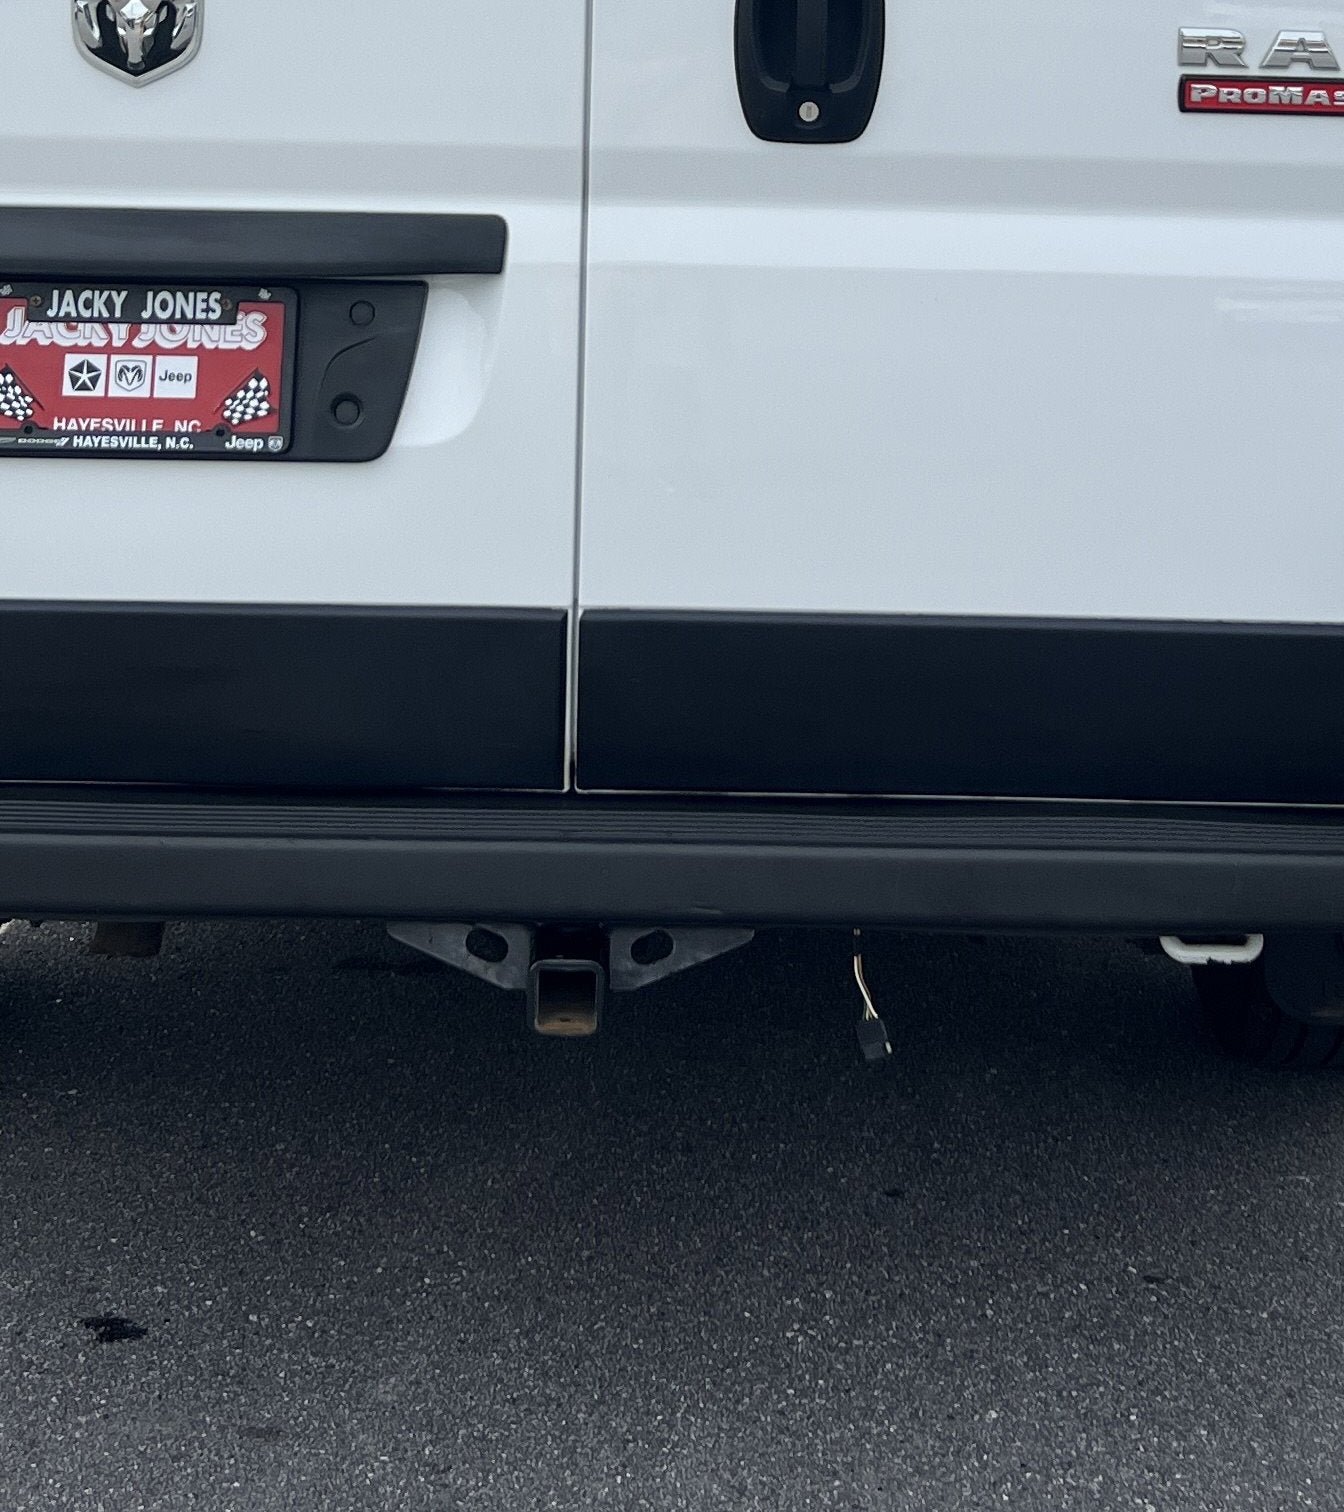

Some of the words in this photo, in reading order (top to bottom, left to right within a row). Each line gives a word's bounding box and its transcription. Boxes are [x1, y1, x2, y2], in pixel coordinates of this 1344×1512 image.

[46, 289, 128, 319] JACKY
[141, 291, 222, 320] JONES
[159, 369, 192, 383] Jeep
[72, 435, 161, 450] HAYESVILLE,
[165, 437, 194, 449] N.C.
[225, 435, 263, 451] Jeep
